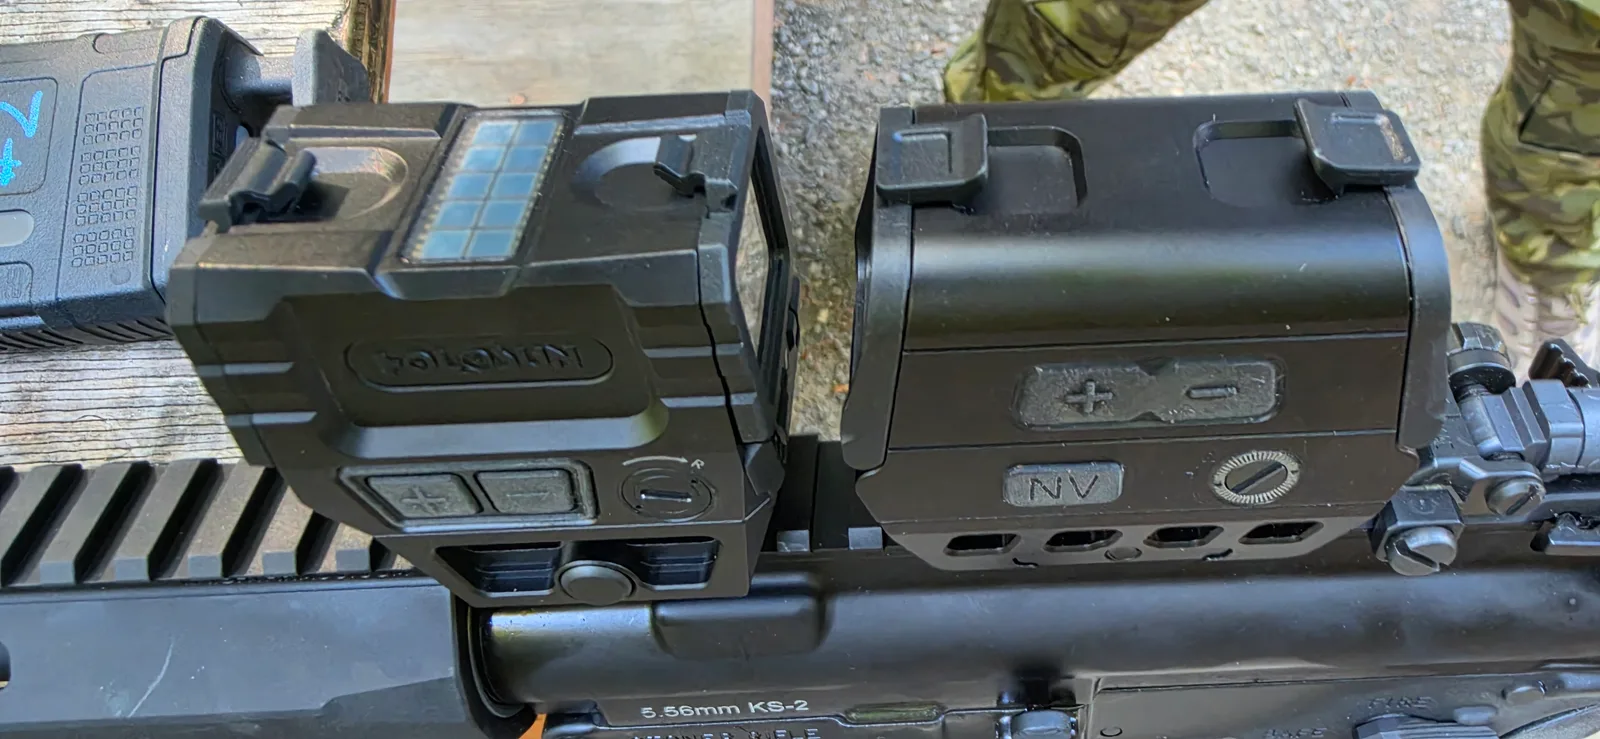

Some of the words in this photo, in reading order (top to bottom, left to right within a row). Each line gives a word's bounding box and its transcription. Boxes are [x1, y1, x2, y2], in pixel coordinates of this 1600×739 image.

[1029, 474, 1099, 500] NV
[640, 704, 741, 719] 5.56mm
[747, 699, 810, 714] KS-2
